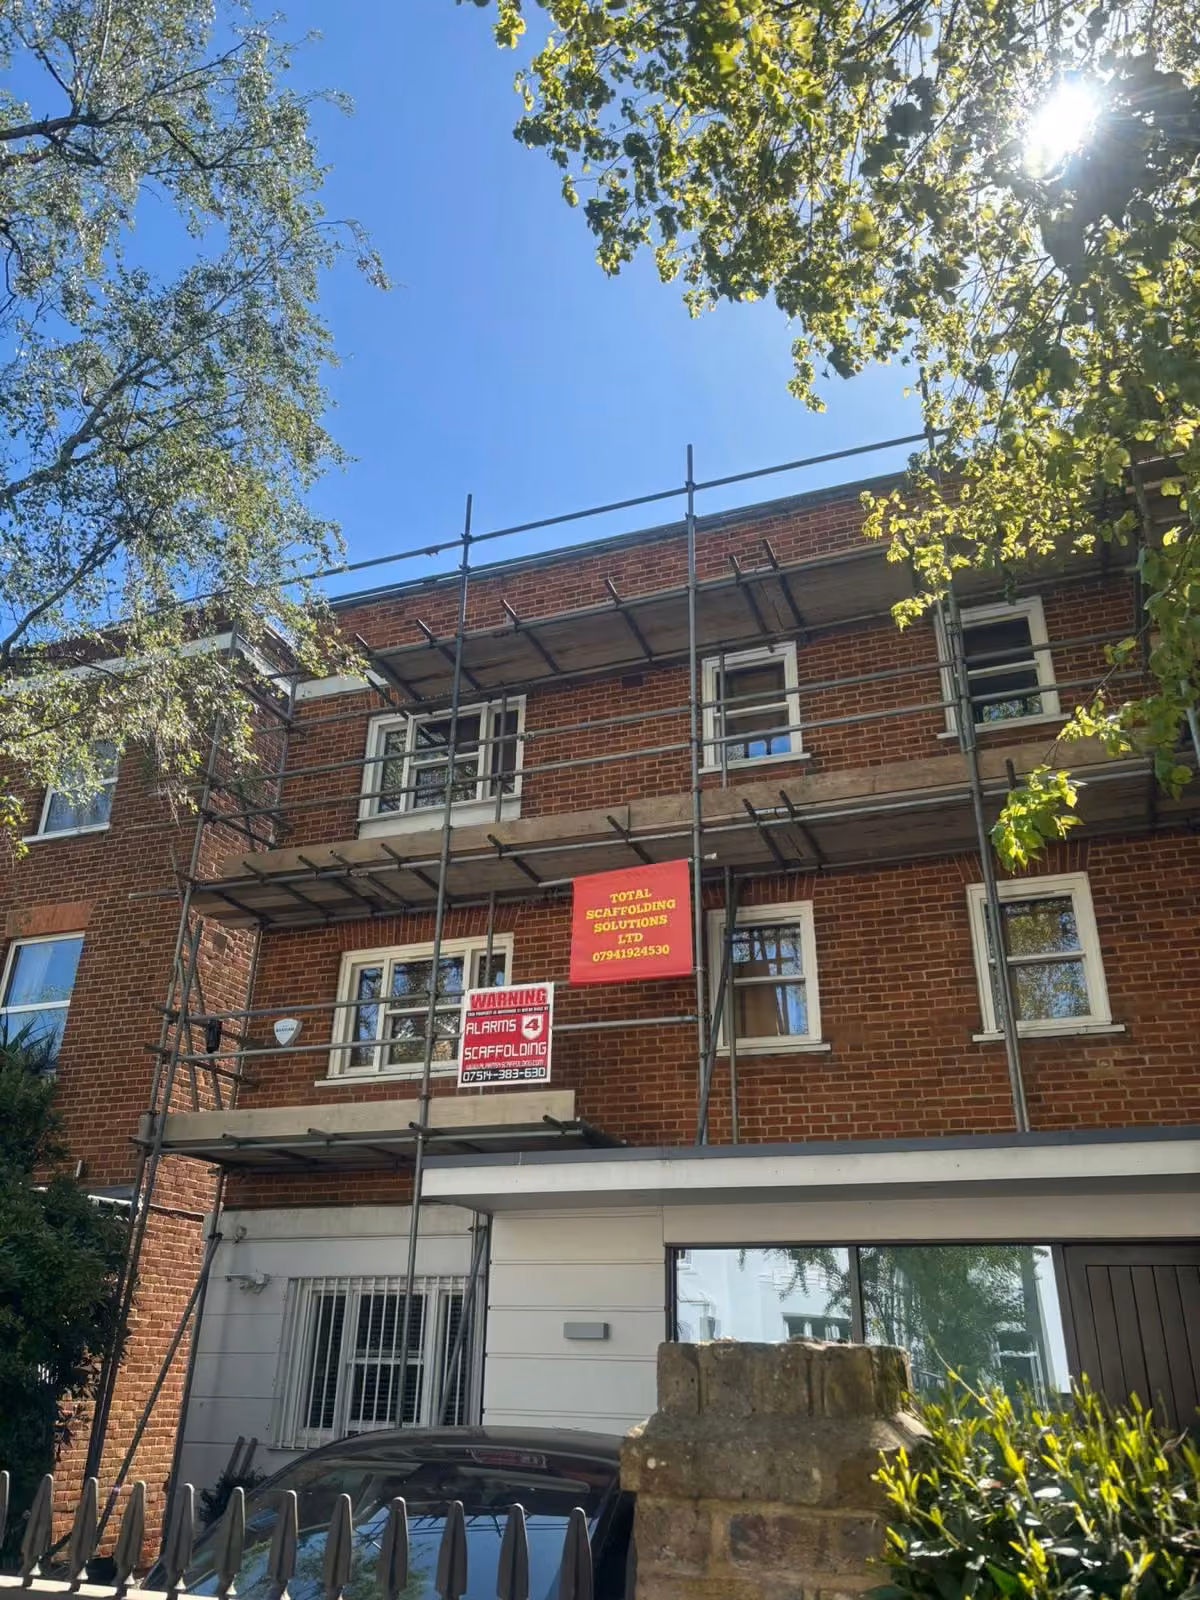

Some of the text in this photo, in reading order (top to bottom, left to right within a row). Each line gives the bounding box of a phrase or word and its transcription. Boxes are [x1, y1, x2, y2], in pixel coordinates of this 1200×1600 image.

[609, 888, 652, 904] TOTAL
[585, 899, 676, 920] SCAFFOLDING
[593, 914, 668, 934] SOLUTIONS
[617, 932, 643, 945] LTD
[592, 944, 670, 963] 07941924530
[470, 988, 548, 1009] WARNING
[466, 1017, 540, 1035] ALARMS 4
[464, 1041, 547, 1060] SCAFFOLDING
[462, 1067, 546, 1082] 07514-383-630
